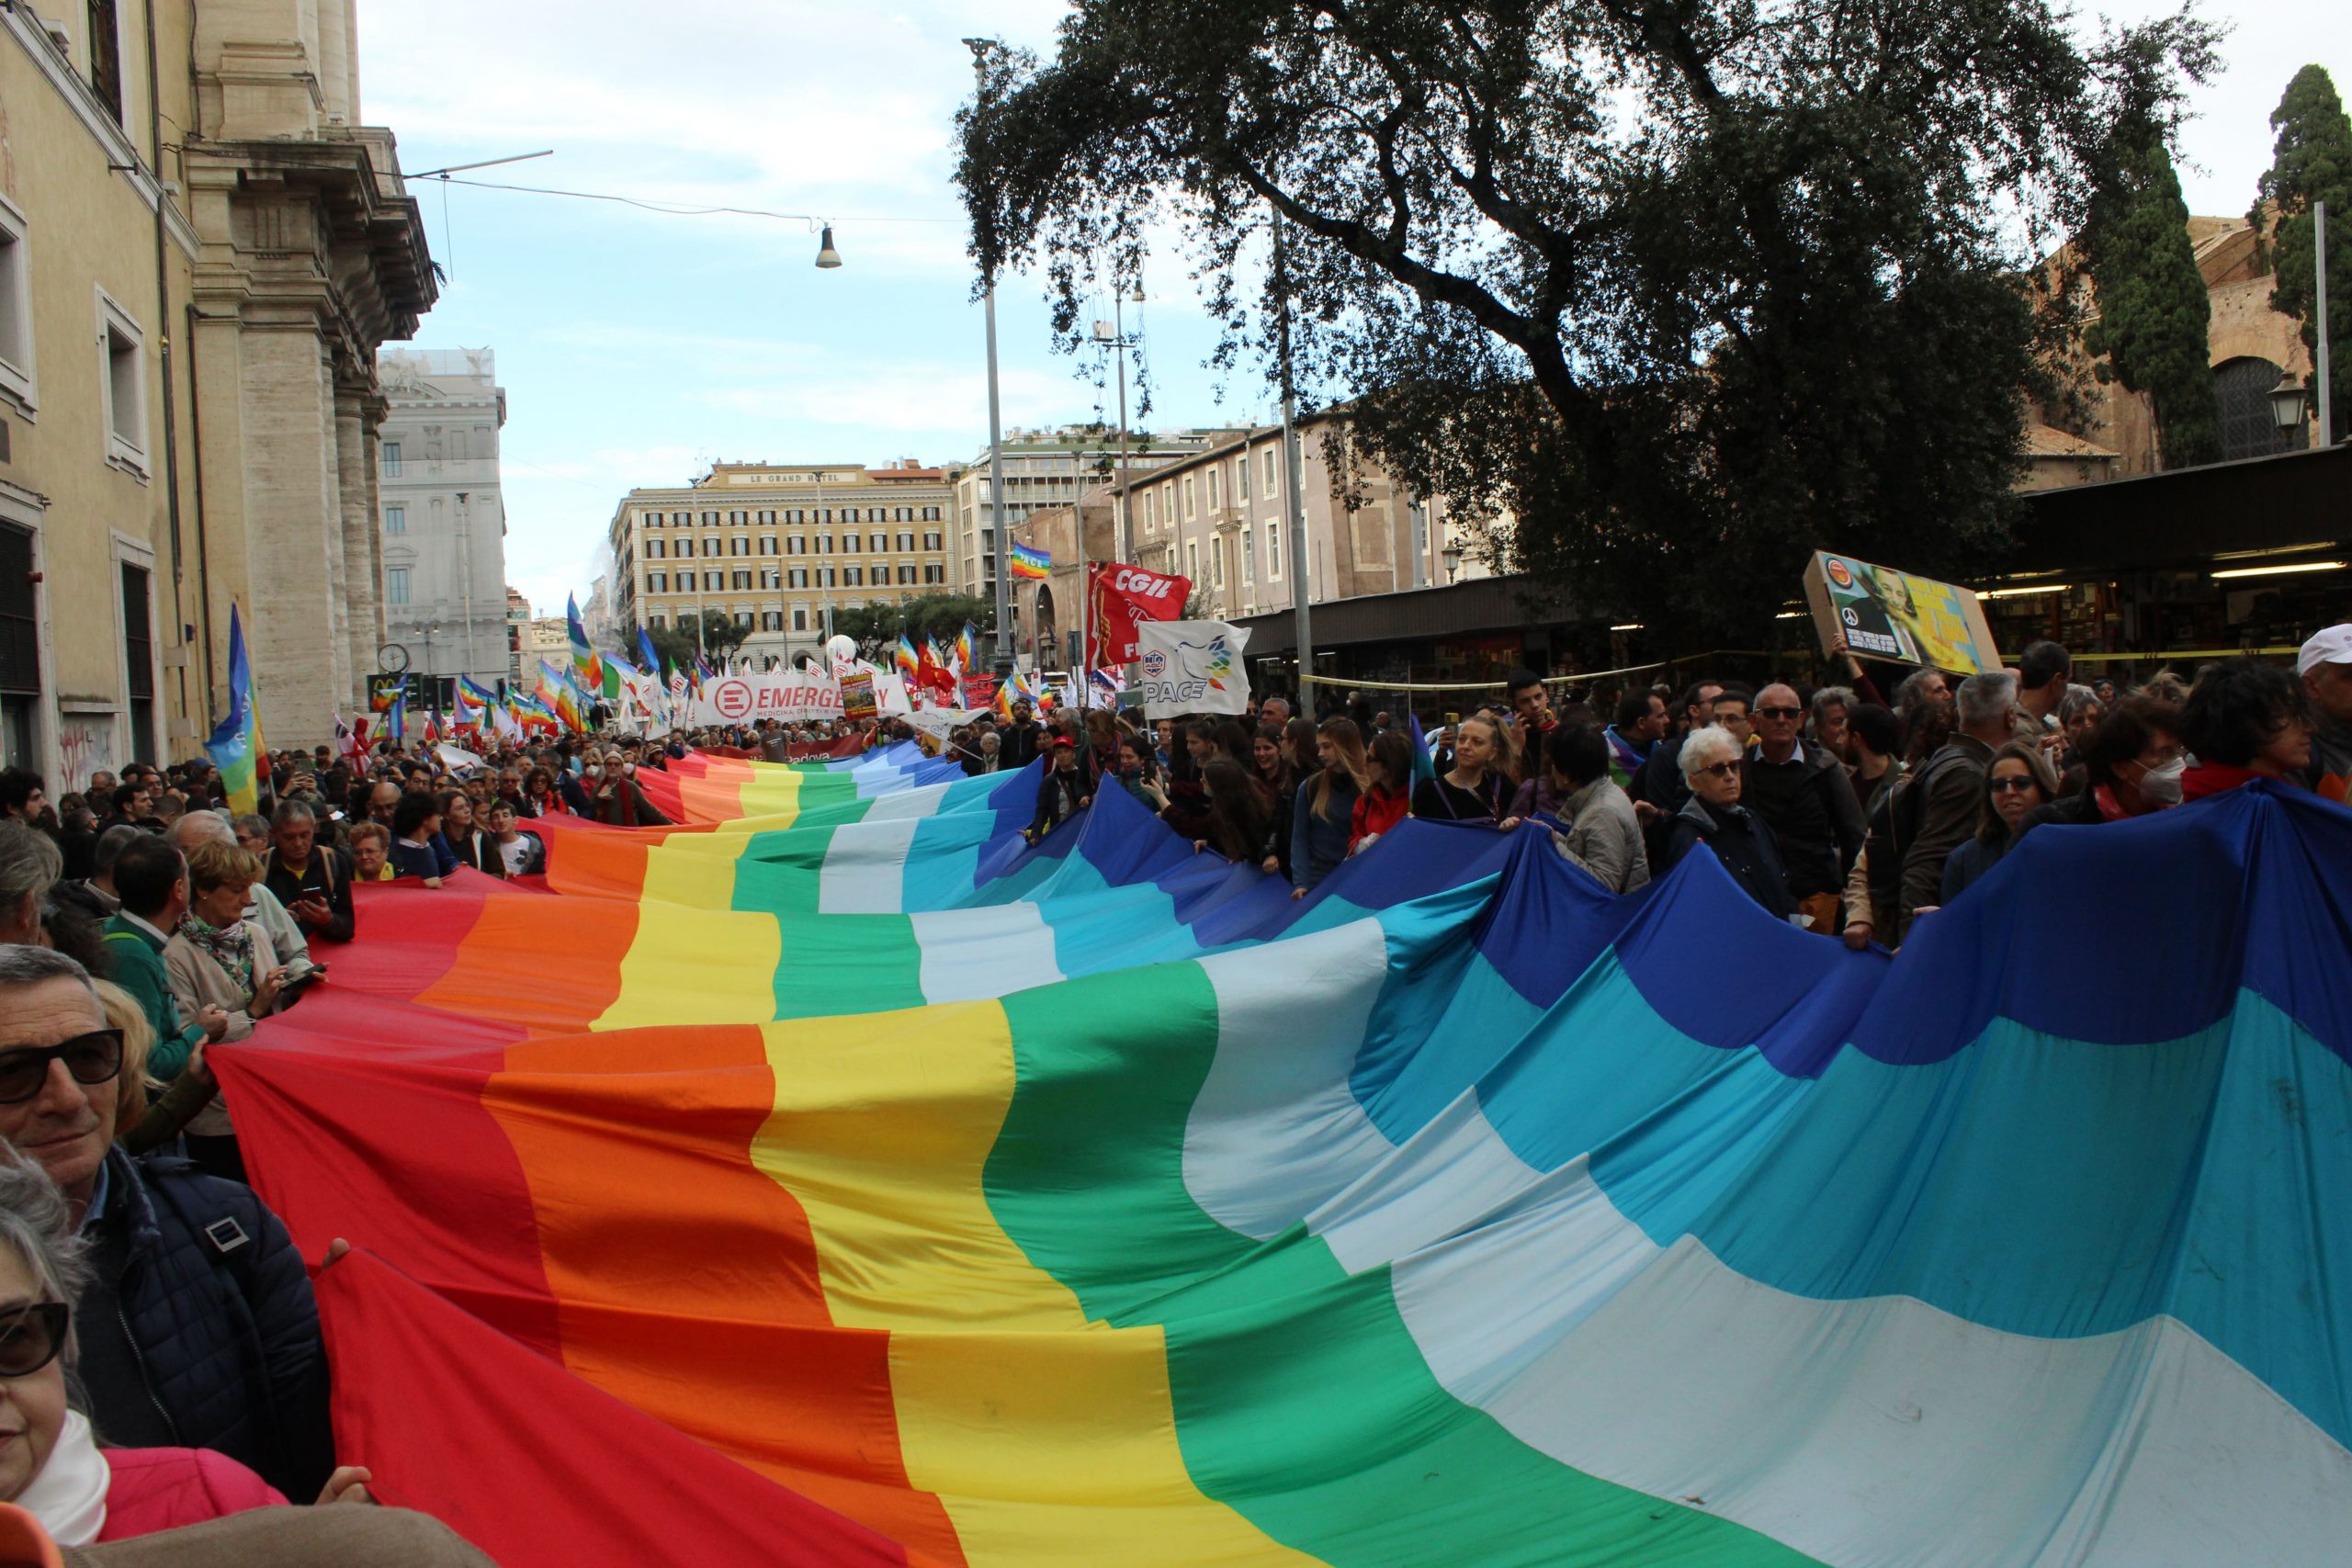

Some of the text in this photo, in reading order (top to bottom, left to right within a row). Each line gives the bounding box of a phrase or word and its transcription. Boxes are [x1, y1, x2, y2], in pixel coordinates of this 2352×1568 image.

[1115, 569, 1173, 599] CGIL
[756, 686, 888, 709] EMERGEY
[1143, 681, 1208, 703] PACE
